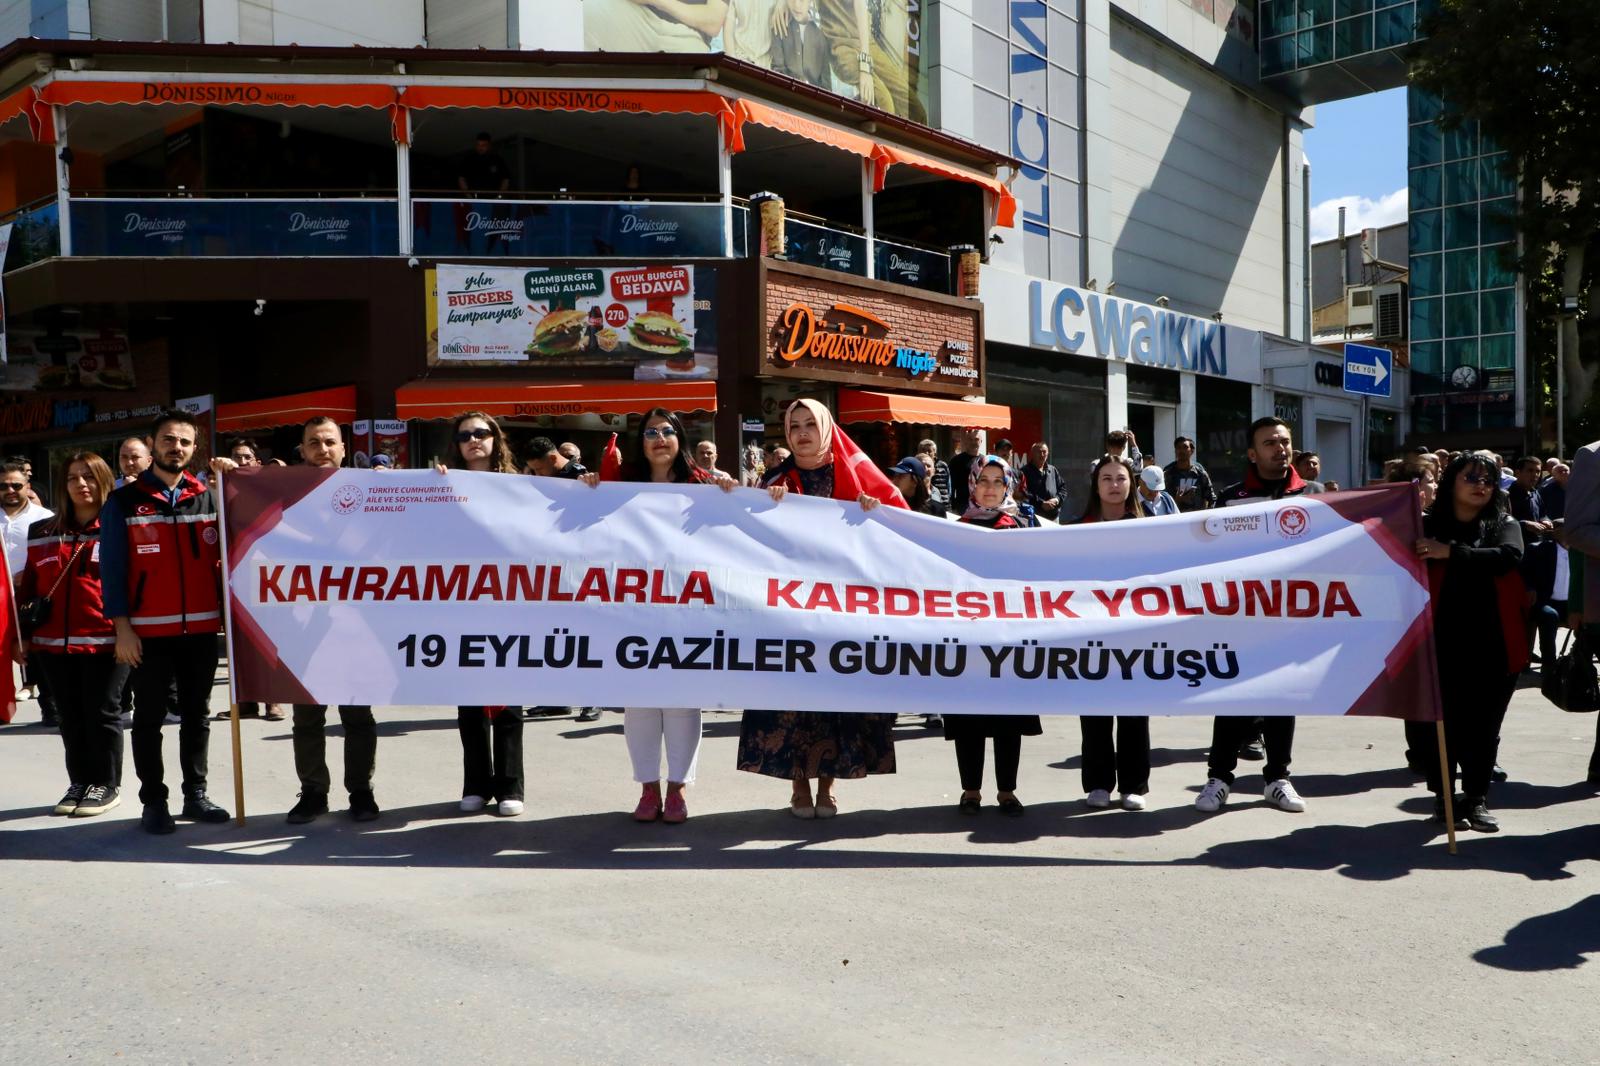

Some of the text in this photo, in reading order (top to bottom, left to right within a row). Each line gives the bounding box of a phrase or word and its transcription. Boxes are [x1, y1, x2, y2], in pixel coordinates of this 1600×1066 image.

[123, 212, 187, 233] Dönissimo
[288, 211, 350, 233] Dönissimo
[464, 212, 525, 232] Dönissimo
[619, 214, 680, 234] Dönissimo
[889, 253, 920, 272] Dönissimo
[530, 272, 594, 285] HAMBURGER
[614, 270, 685, 284] TAVUK BURGER
[530, 283, 597, 295] MENÜ ALANA
[622, 280, 685, 296] BEDAVA
[448, 290, 514, 307] BURGERS
[447, 306, 524, 327] kampanyası
[1028, 280, 1086, 353] LC
[780, 302, 938, 376] Dönissimo Niğde
[1348, 363, 1360, 373] TEK
[366, 495, 383, 503] AİLE
[395, 495, 423, 503] SOSYAL
[368, 486, 400, 494] TÜRKİYE
[364, 504, 406, 513] BAKANLIĞI
[259, 563, 1361, 623] KAHRAMANLARLA KARDEŞLİK YOLUNDA
[397, 628, 1240, 688] 19 EYLÜL GAZİLER GÜNÜ YÜRÜYÜŞÜ
